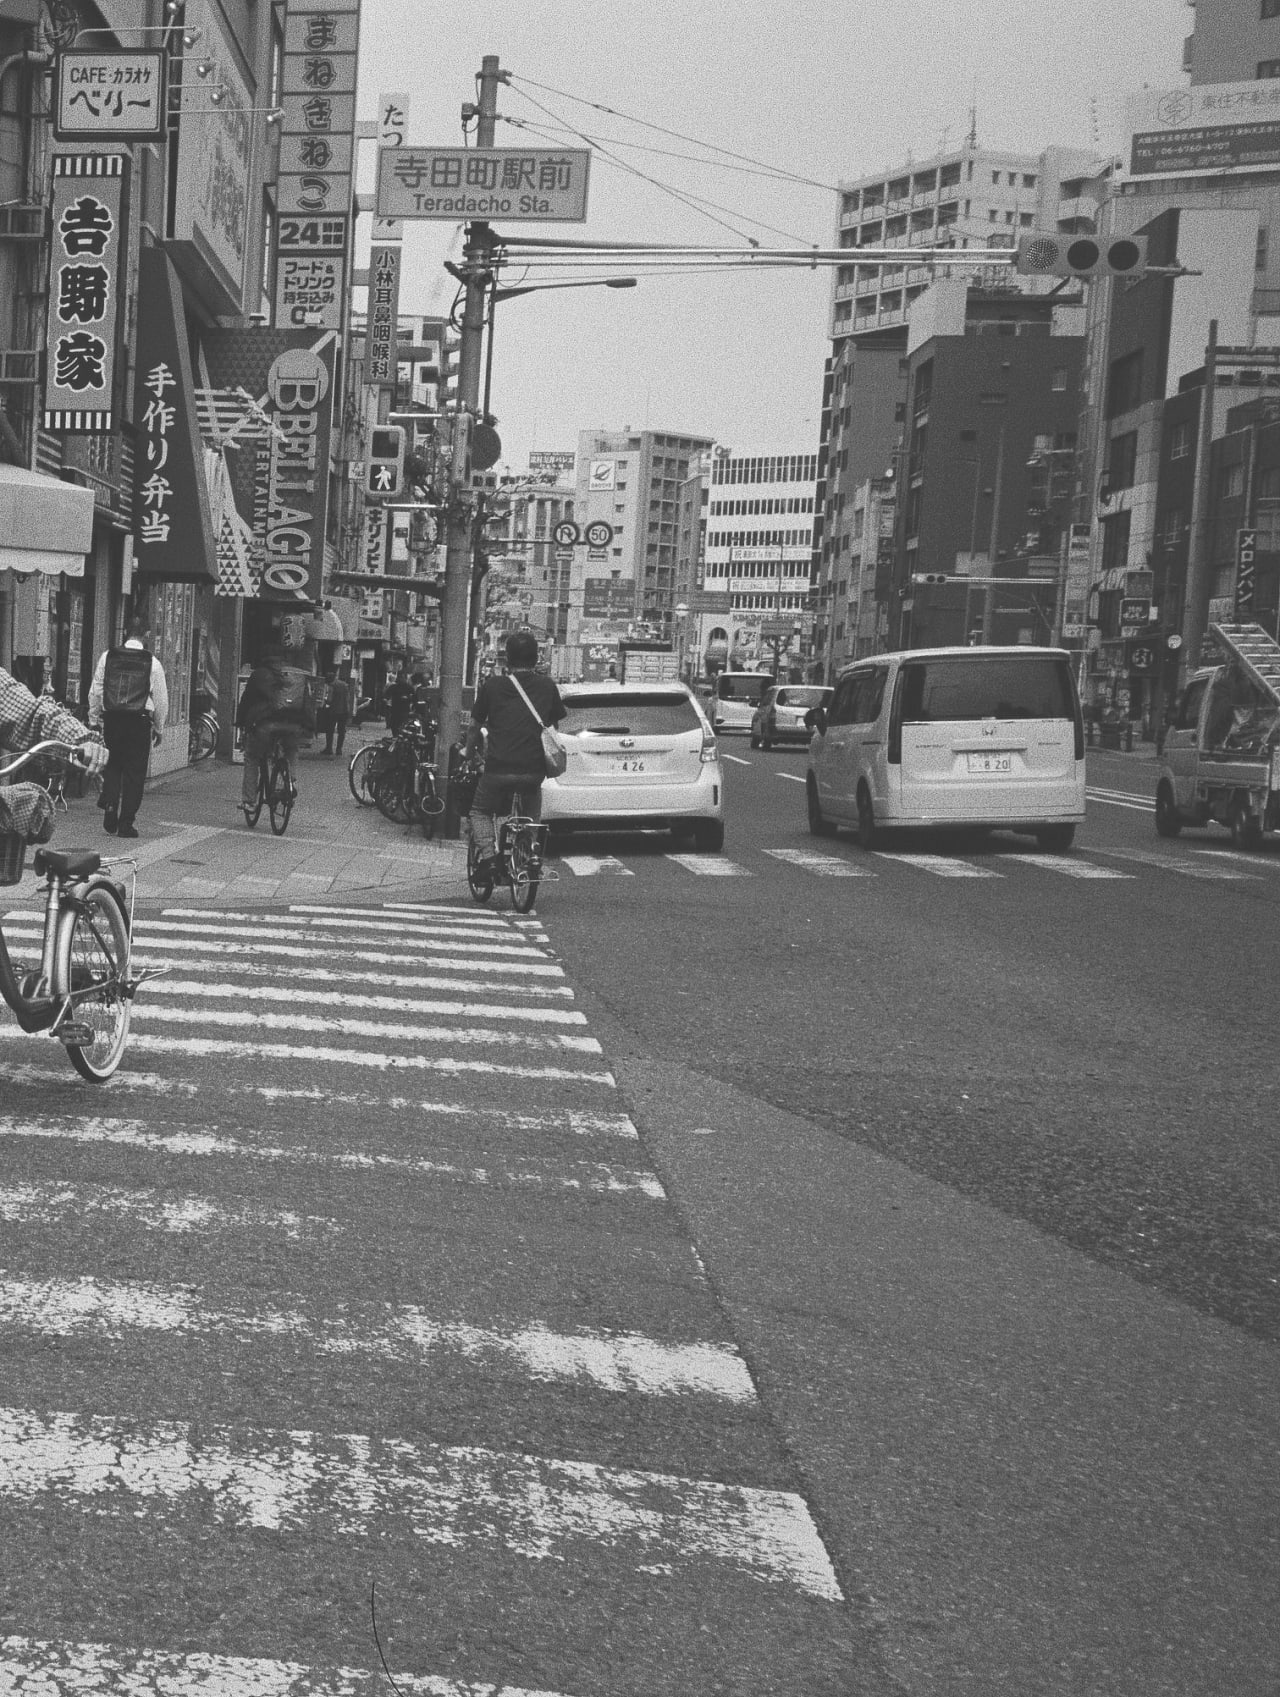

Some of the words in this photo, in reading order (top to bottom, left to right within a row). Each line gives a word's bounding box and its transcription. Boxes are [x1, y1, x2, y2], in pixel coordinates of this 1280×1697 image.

[69, 89, 151, 117] ベリー
[296, 14, 338, 211] まねきねこ
[393, 155, 573, 190] 寺田町駅前
[413, 194, 511, 212] Teradacho
[519, 196, 554, 214] Sta.
[56, 196, 113, 389] 吉野家
[283, 291, 335, 304] 持ち込み
[284, 276, 335, 290] ドリンク
[371, 251, 394, 379] 小林耳鼻咽喉科
[139, 361, 177, 544] 手作り弁当
[590, 528, 607, 541] 50
[1237, 533, 1256, 604] メロンパン
